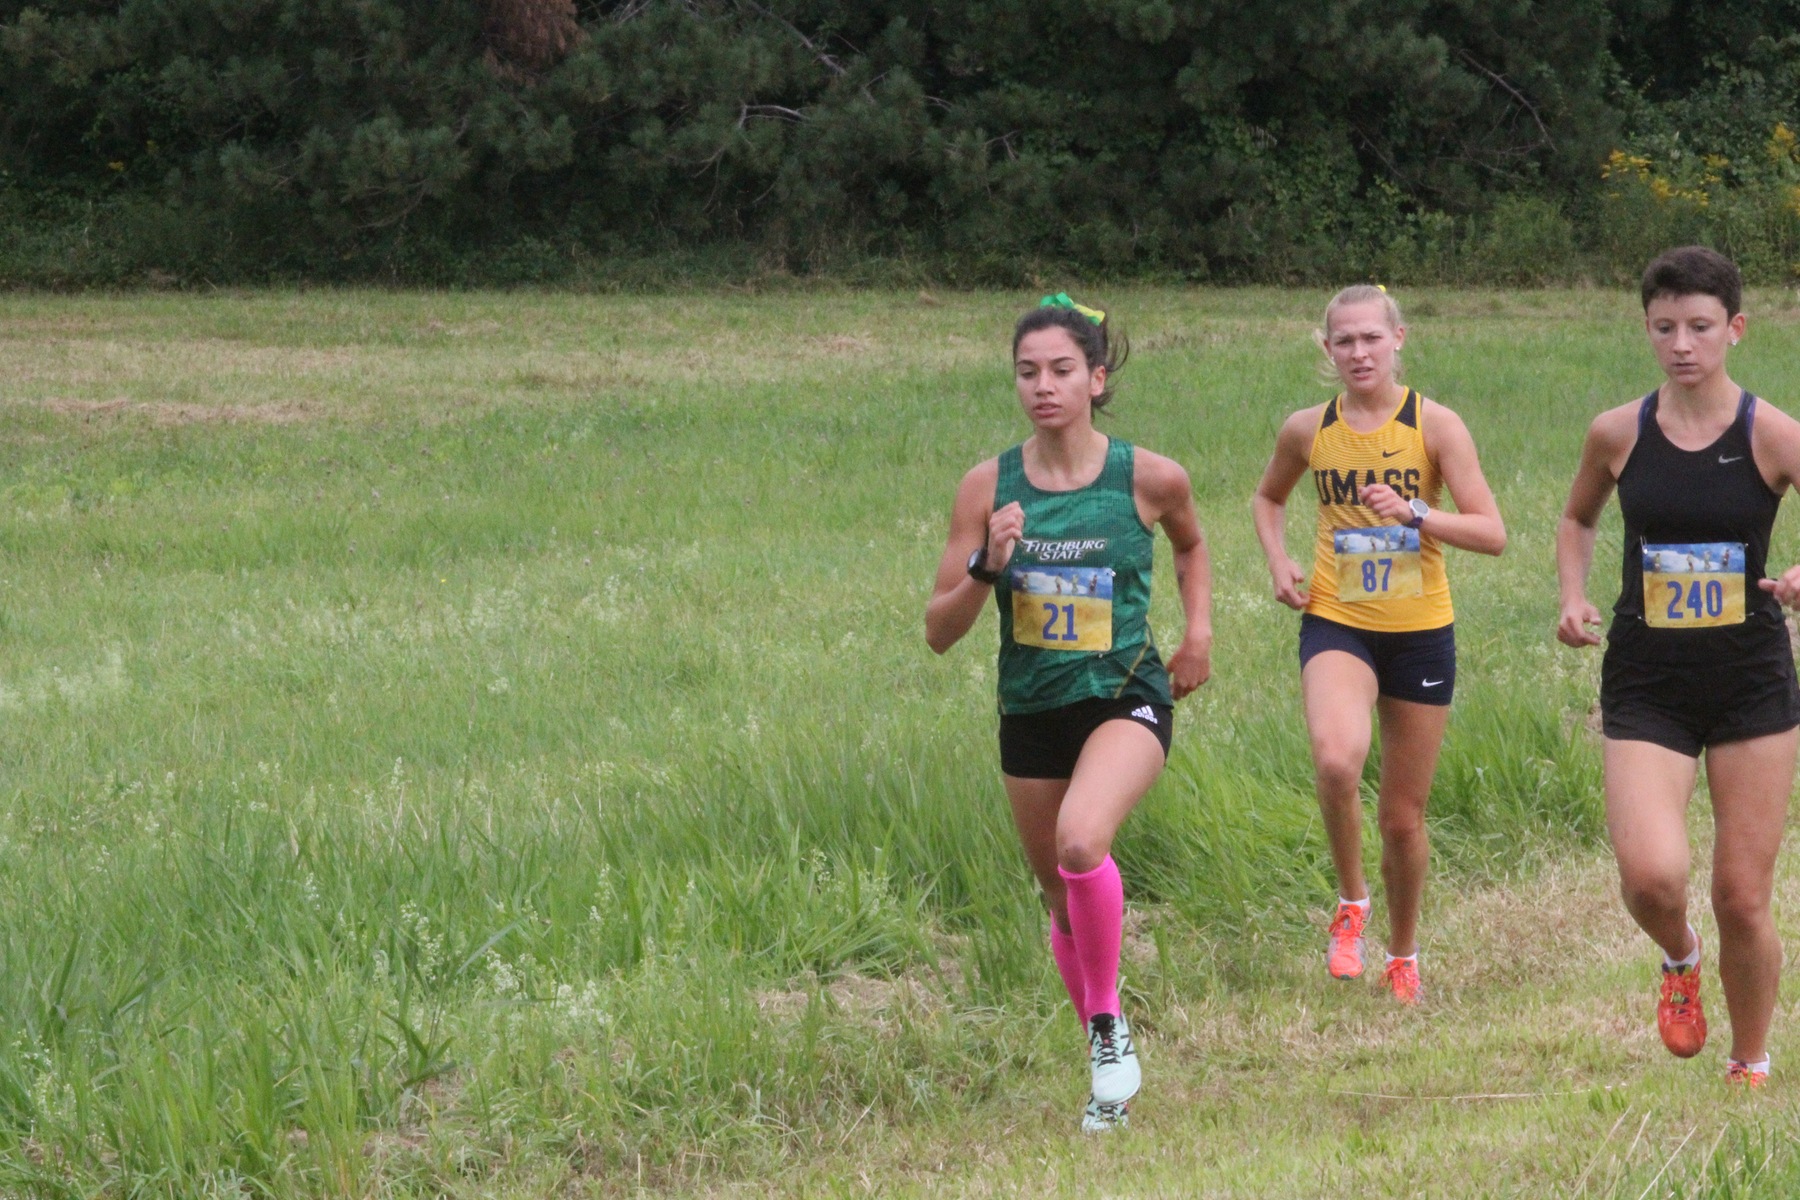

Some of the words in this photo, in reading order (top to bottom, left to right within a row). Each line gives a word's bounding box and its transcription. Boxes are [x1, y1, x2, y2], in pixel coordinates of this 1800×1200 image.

[1022, 540, 1105, 552] FITCHBURG
[1040, 550, 1083, 560] STATE
[1362, 558, 1392, 592] 87
[1667, 580, 1722, 619] 240
[1042, 603, 1078, 640] 21
